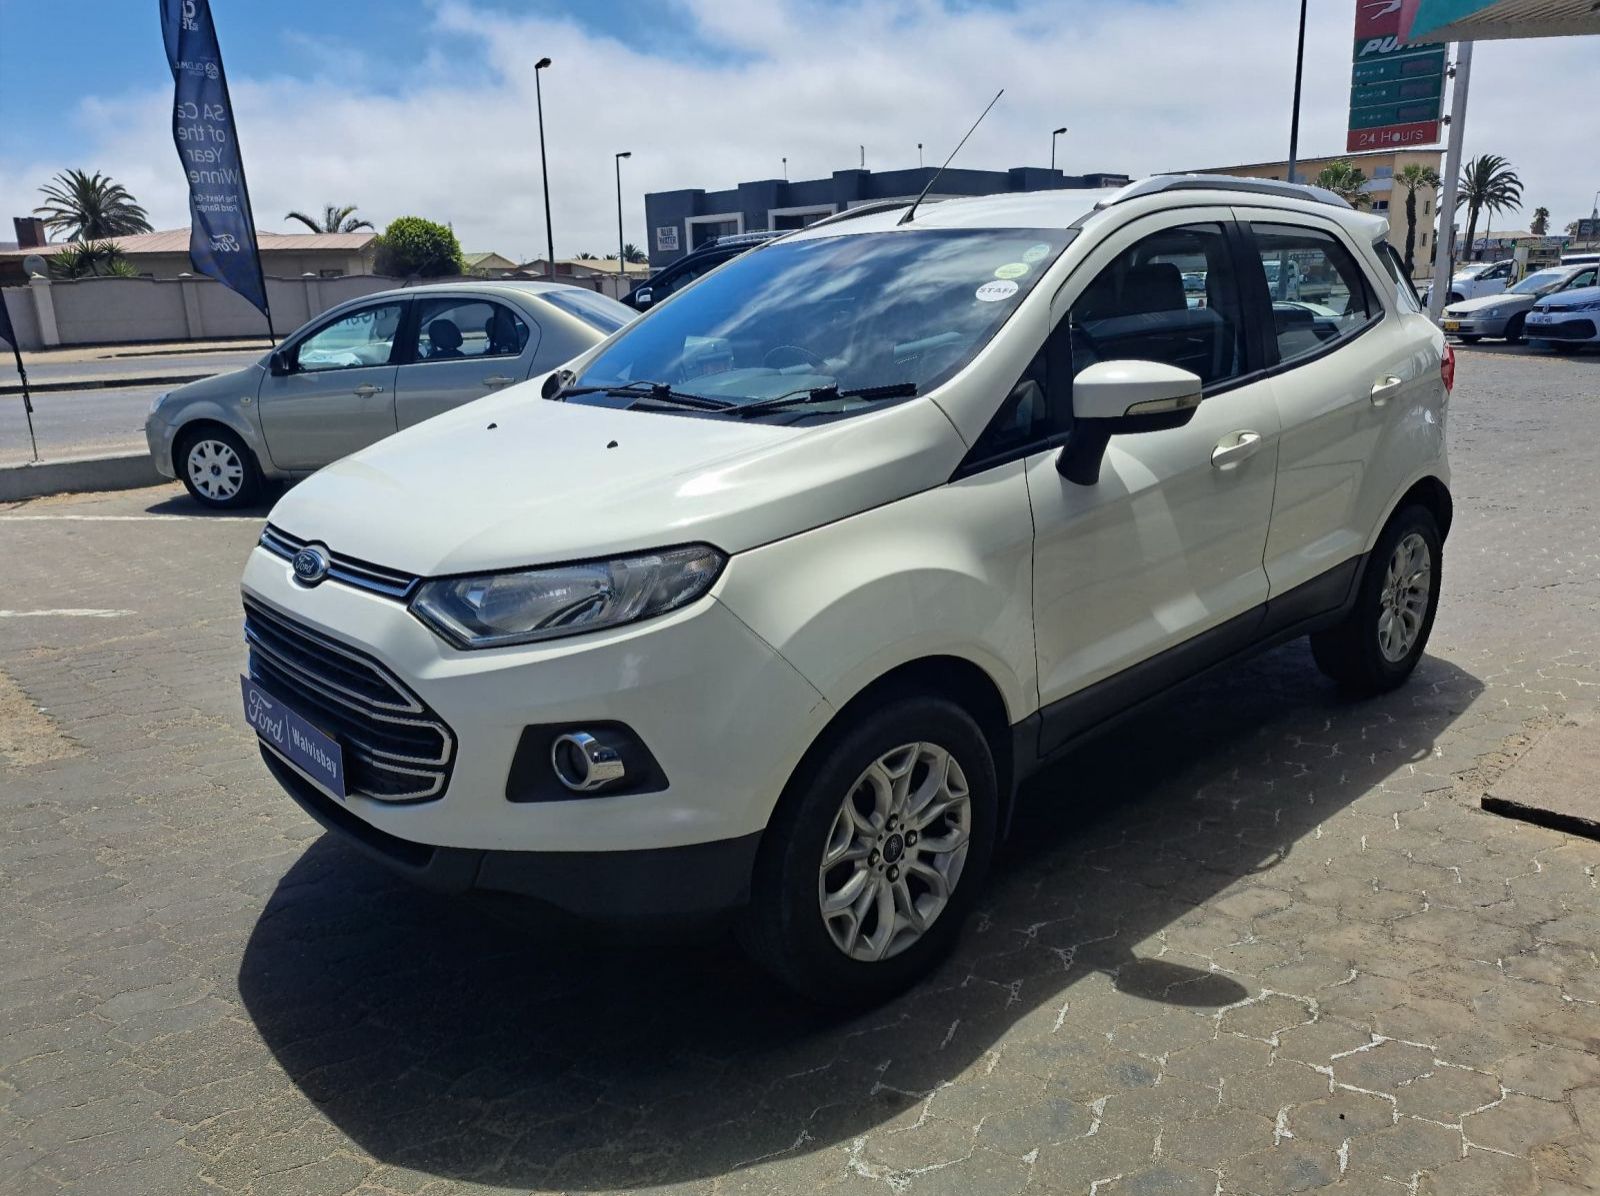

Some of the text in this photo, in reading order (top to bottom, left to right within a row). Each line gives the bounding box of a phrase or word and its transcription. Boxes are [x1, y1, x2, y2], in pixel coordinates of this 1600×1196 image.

[1359, 35, 1434, 56] PU
[1360, 129, 1423, 146] 24 Hours
[295, 553, 315, 574] Ford
[248, 689, 337, 778] Ford Walvisbay
